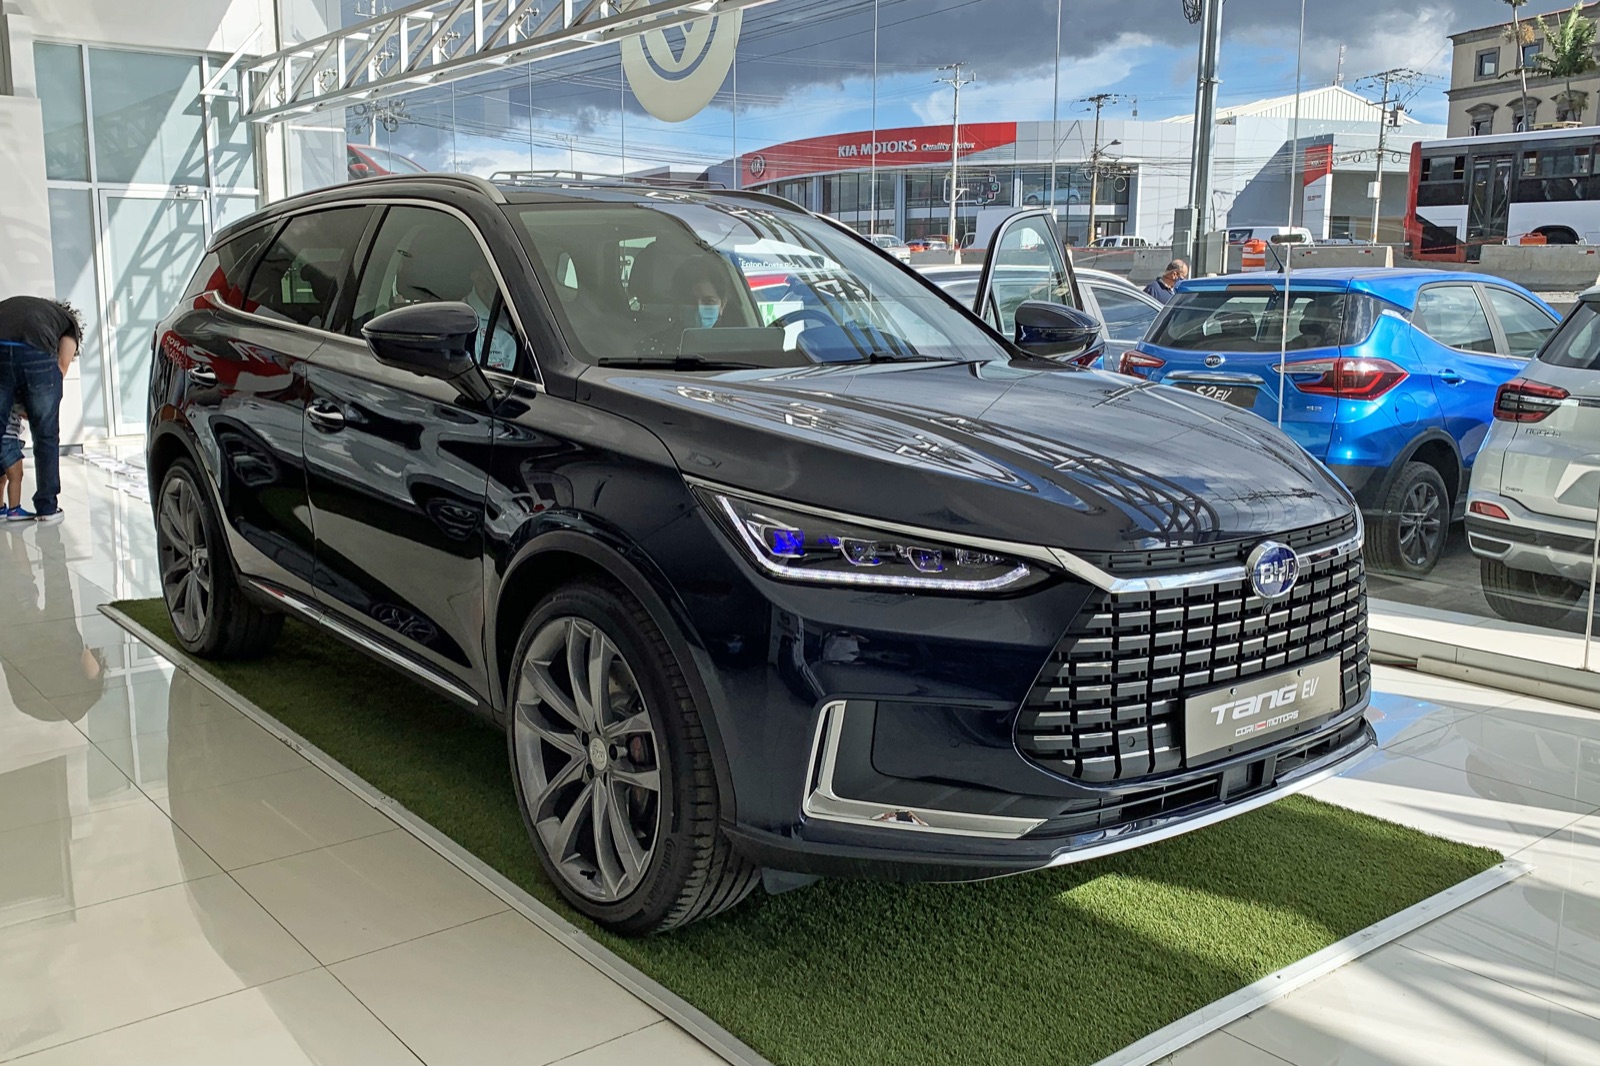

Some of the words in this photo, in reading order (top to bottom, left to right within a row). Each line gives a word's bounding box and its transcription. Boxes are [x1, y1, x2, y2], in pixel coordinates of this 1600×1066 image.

[838, 144, 858, 157] KIA
[860, 138, 917, 155] MOTORS
[921, 142, 951, 152] Quality
[1206, 356, 1221, 365] BYD
[1215, 389, 1232, 401] EV
[1259, 558, 1295, 584] BYD
[1301, 676, 1320, 700] EV
[1266, 710, 1300, 728] MOTORS
